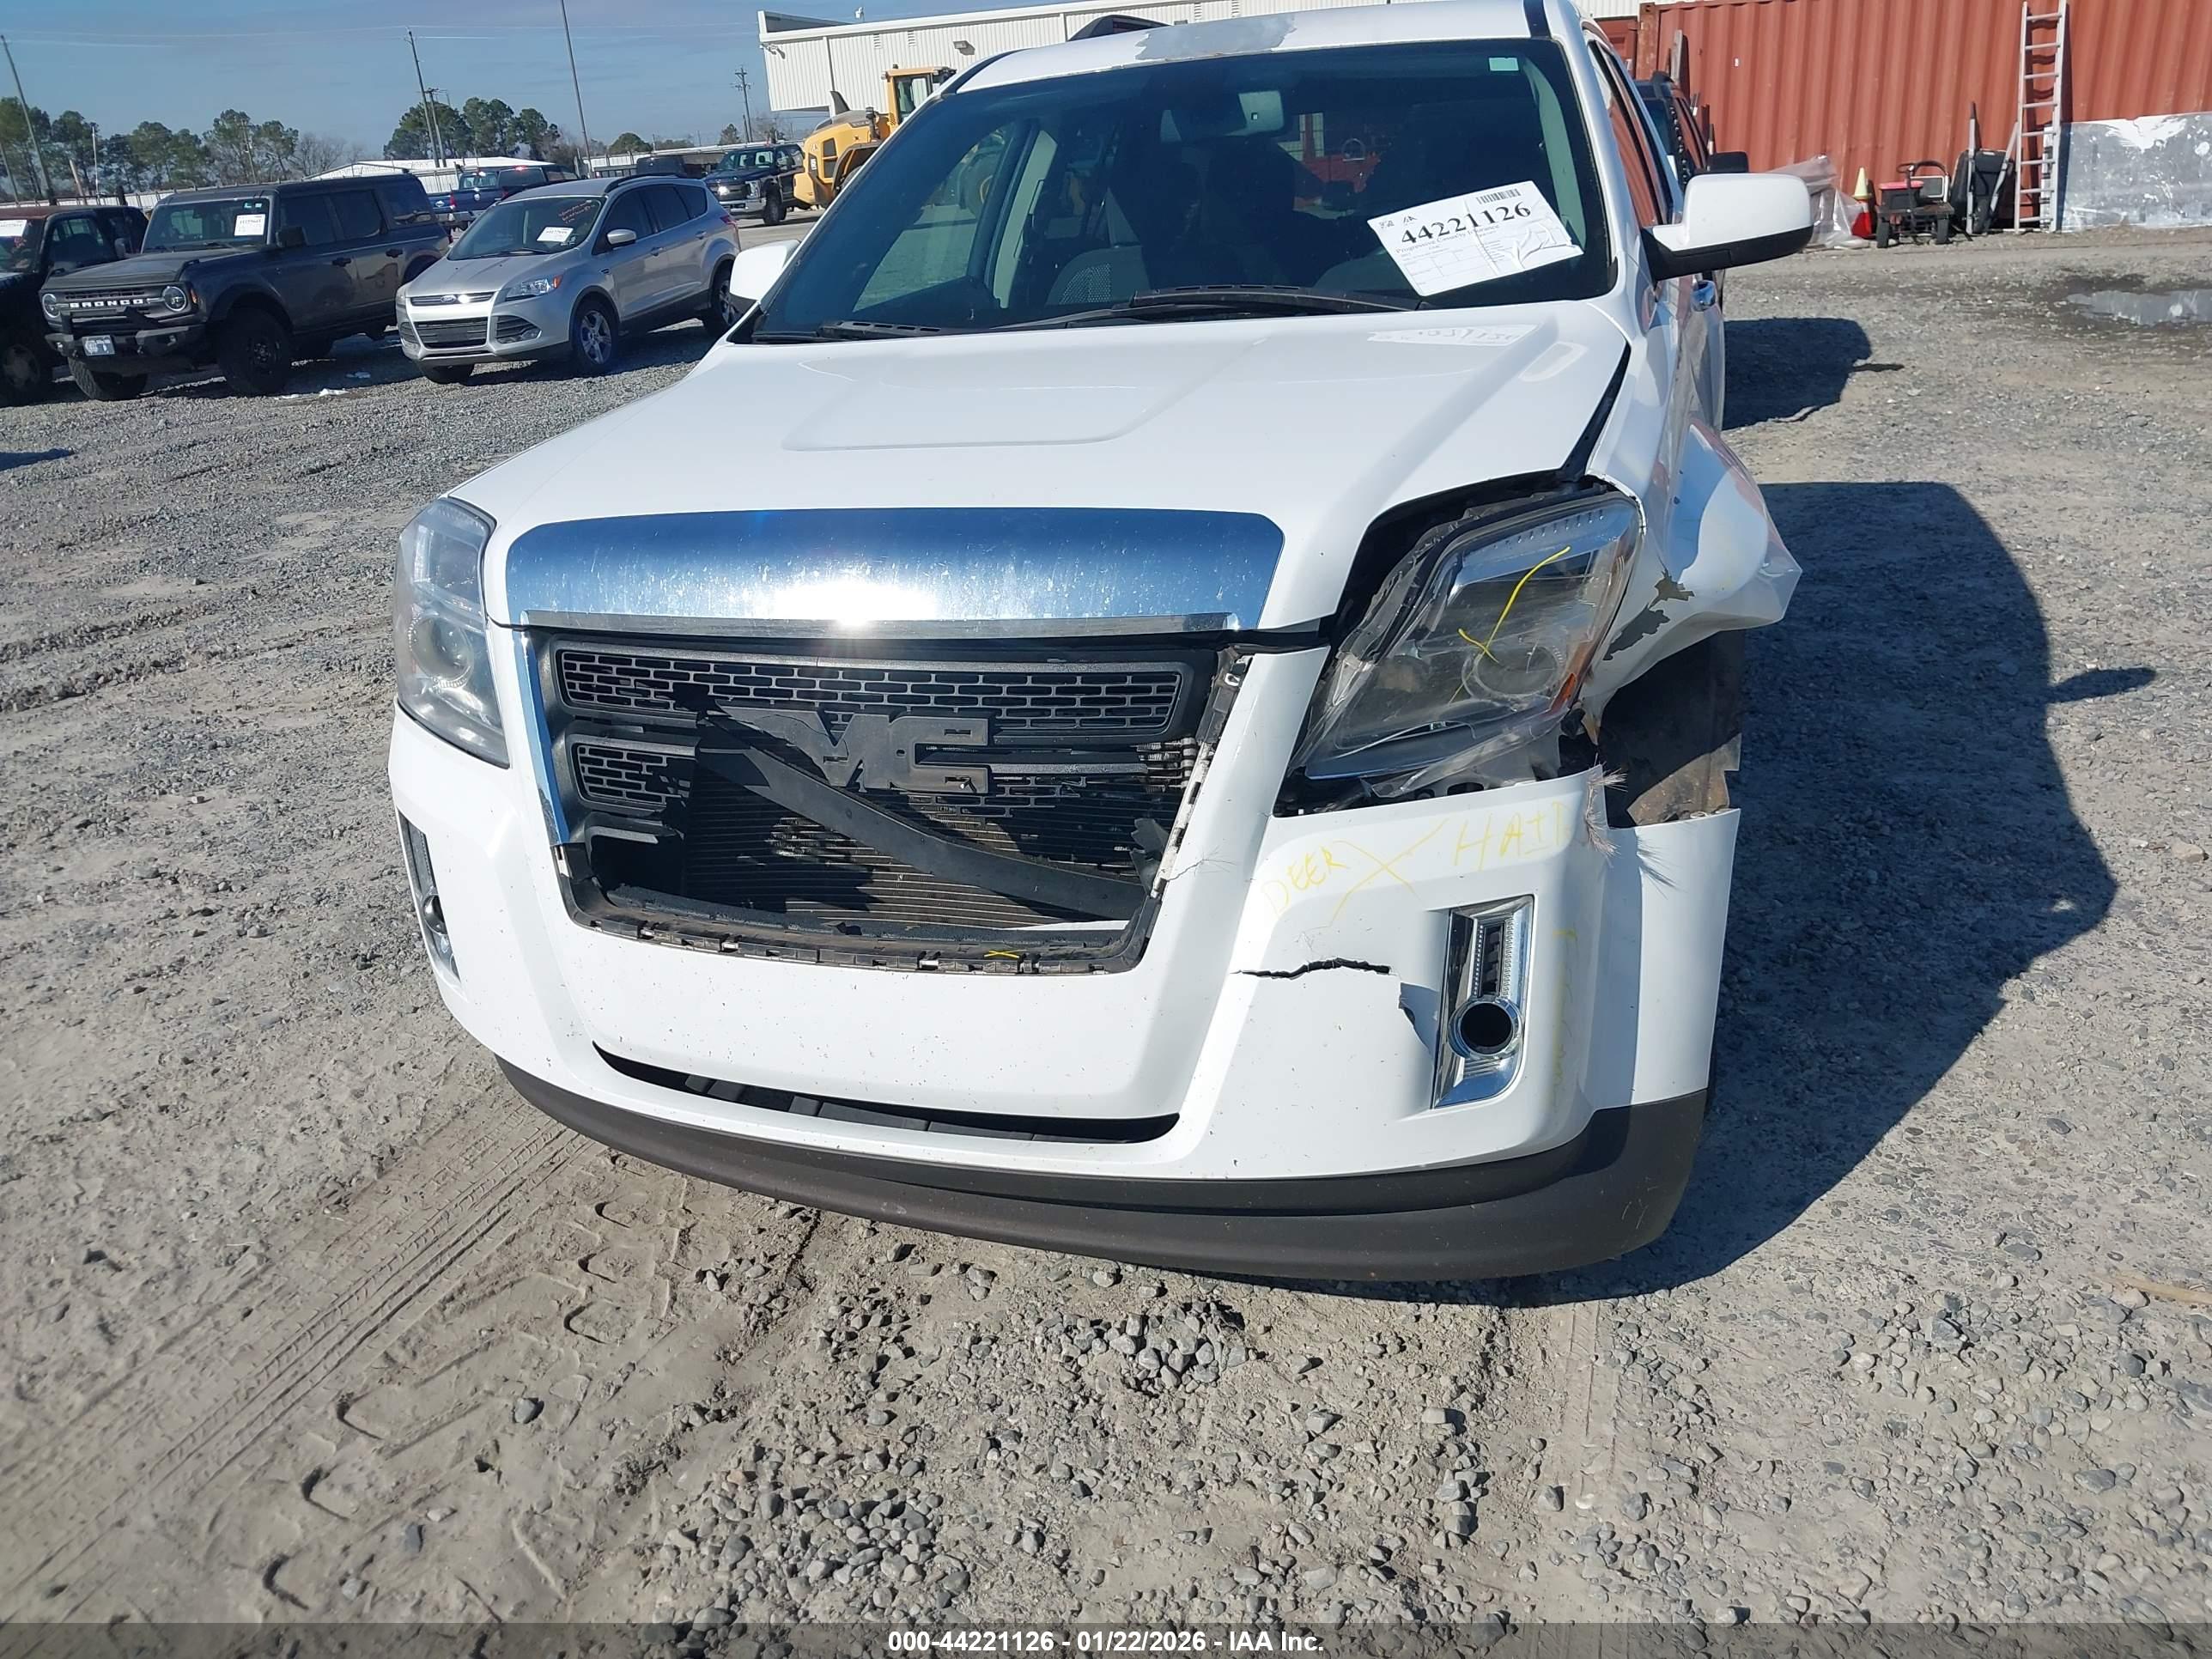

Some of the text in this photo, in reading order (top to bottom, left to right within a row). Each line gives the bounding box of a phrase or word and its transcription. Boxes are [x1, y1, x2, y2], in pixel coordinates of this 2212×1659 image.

[1401, 200, 1531, 244] 44221126
[70, 298, 143, 308] BRONCO
[1261, 844, 1349, 915] DEER
